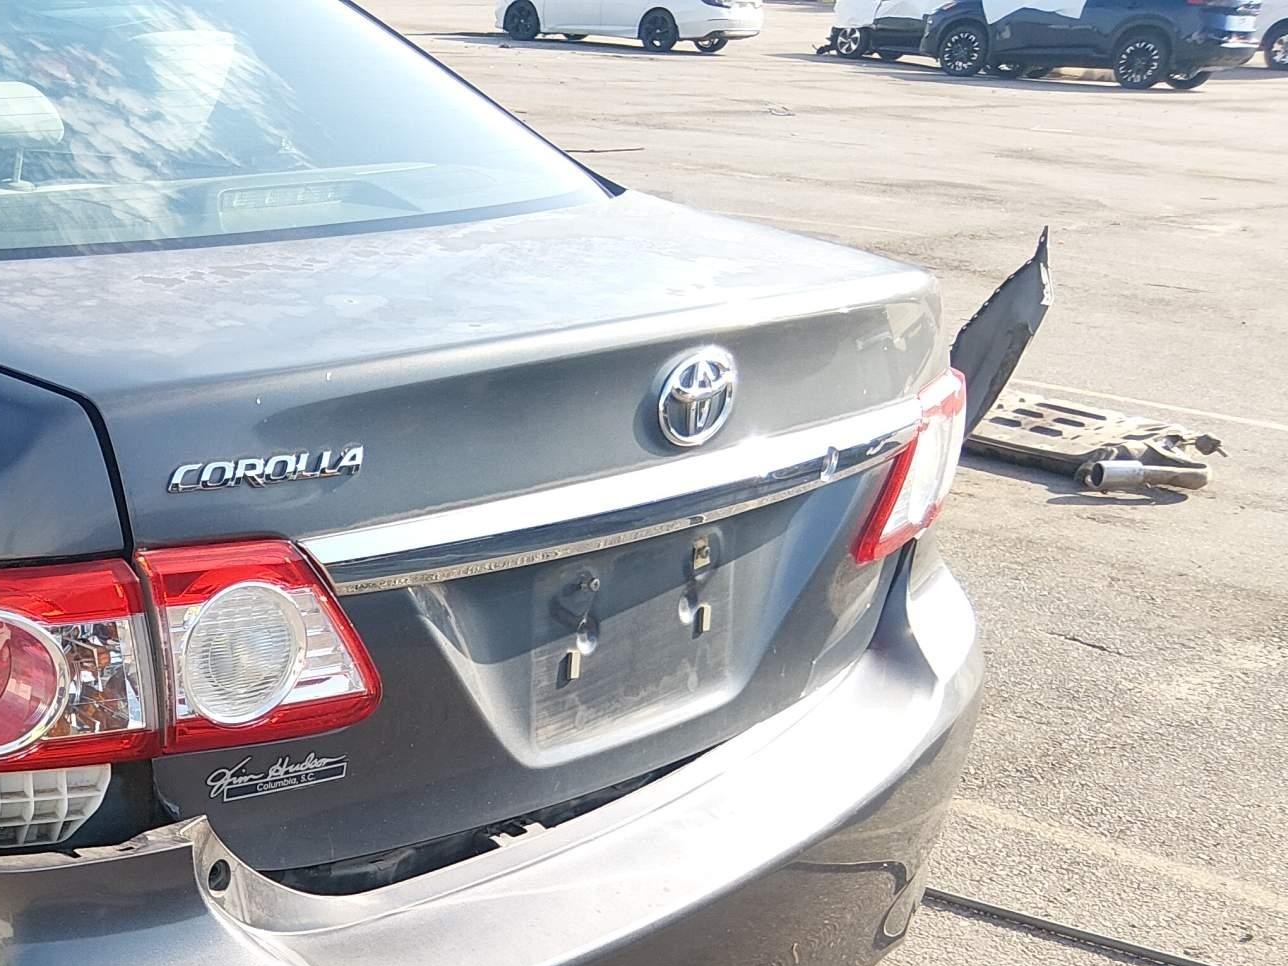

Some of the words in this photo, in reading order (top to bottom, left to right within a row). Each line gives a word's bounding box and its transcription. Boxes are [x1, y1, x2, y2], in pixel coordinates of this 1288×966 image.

[167, 445, 364, 493] COROLLA
[206, 756, 265, 798] Jim
[267, 752, 347, 780] Hudson
[257, 775, 299, 791] Columbia,
